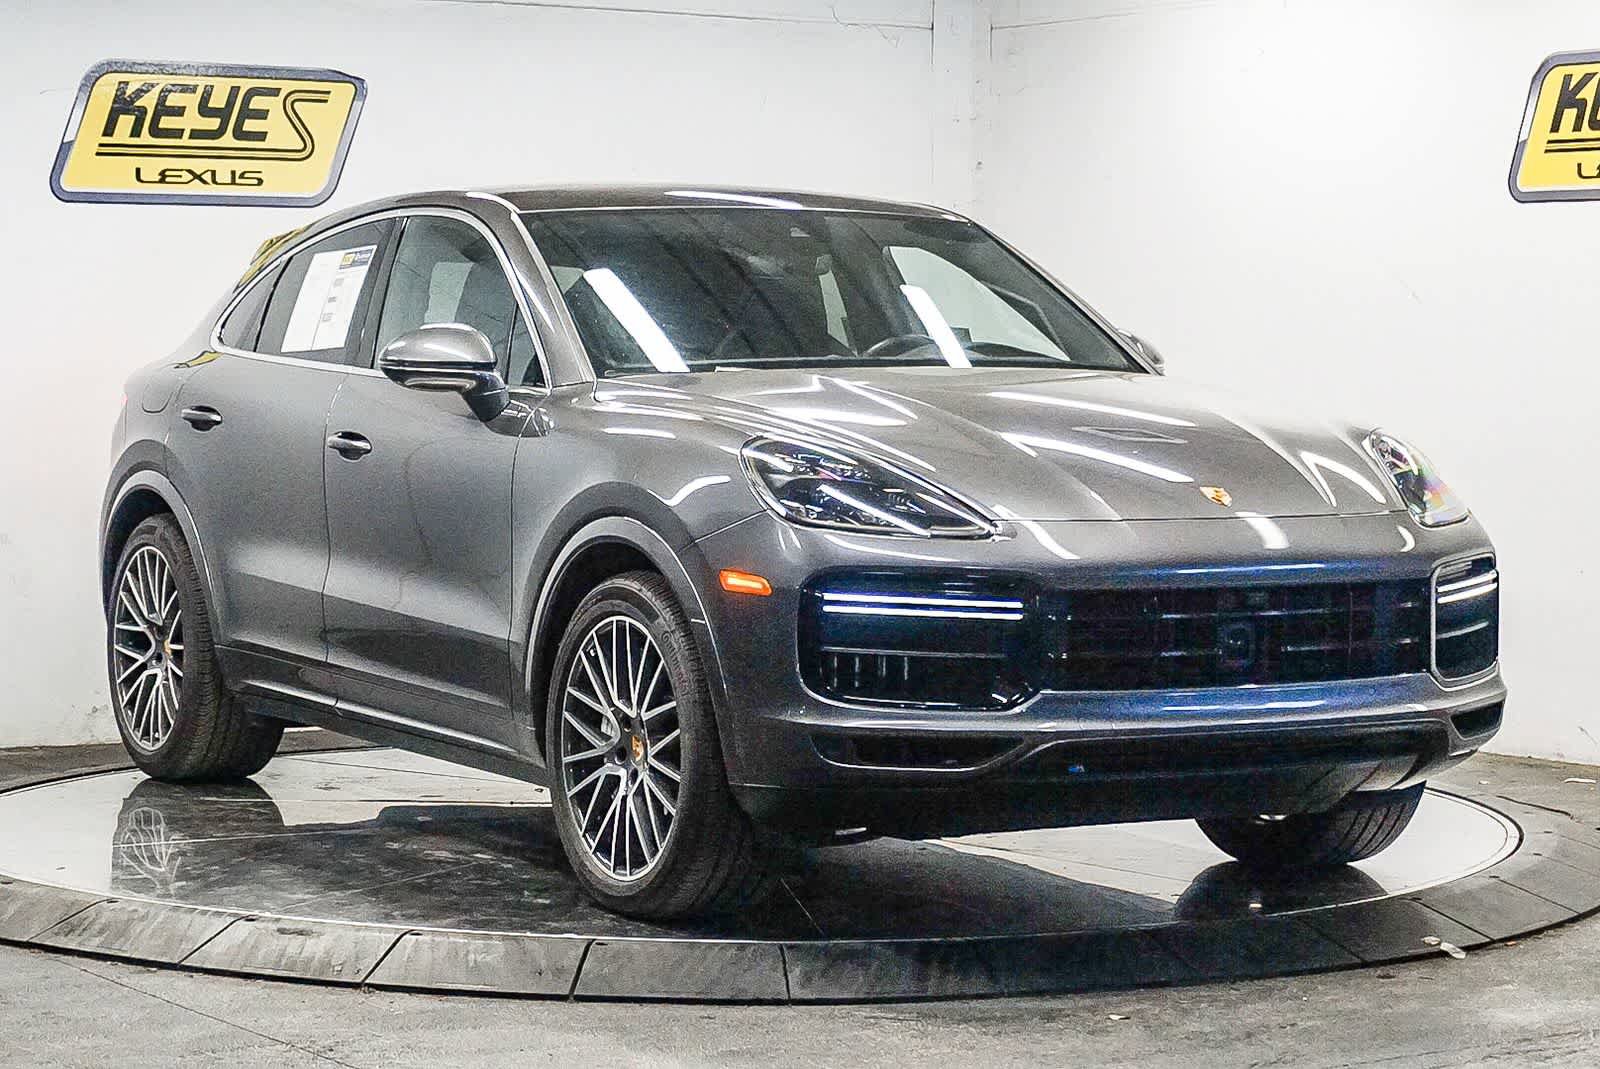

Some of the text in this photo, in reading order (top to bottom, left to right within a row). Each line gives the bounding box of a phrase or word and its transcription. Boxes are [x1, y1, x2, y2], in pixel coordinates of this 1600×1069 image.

[98, 81, 332, 161] KEYES
[1549, 72, 1600, 133] K
[135, 167, 264, 187] LEXUS
[1577, 163, 1600, 179] L
